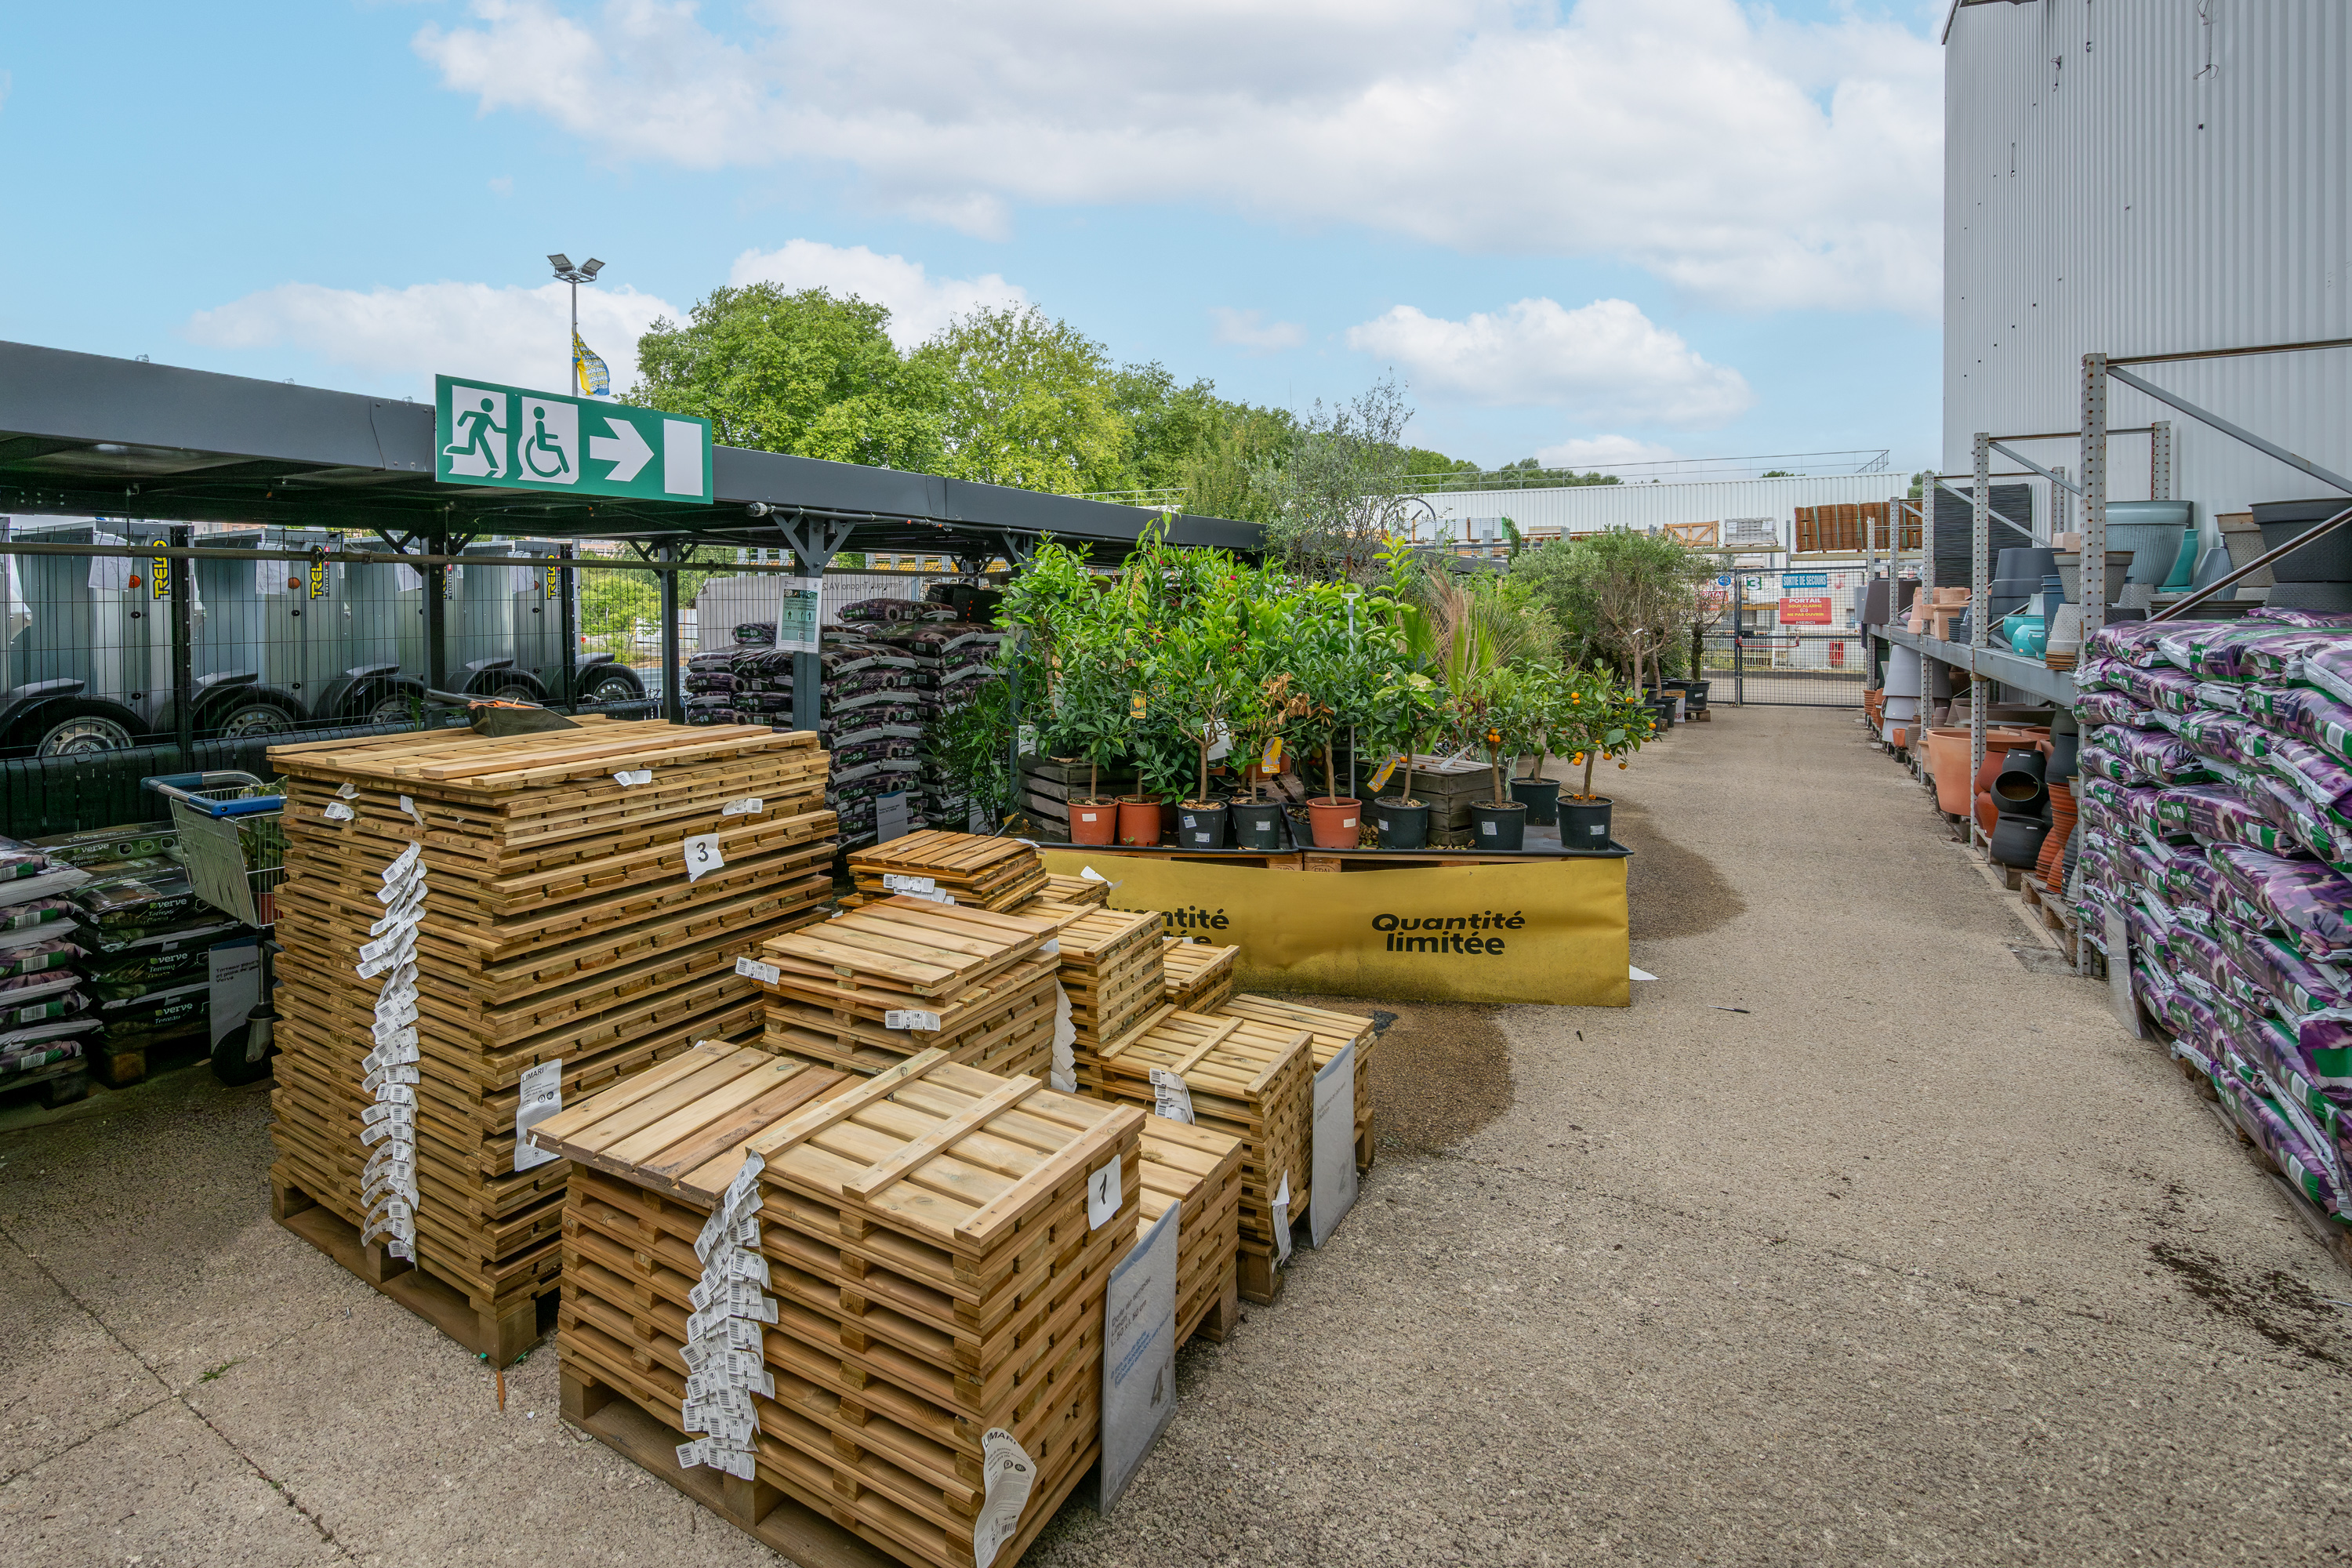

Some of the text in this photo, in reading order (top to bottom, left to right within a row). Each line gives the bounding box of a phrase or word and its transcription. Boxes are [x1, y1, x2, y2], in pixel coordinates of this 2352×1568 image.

[1747, 576, 1761, 590] 3
[1784, 575, 1827, 586] SORTIE DE SECOURS
[81, 844, 109, 853] verve
[696, 841, 709, 862] 3
[158, 898, 187, 909] verve
[1372, 910, 1526, 931] Quantité
[1387, 931, 1505, 955] limitée
[158, 953, 188, 964] verve
[163, 1003, 193, 1014] verve
[521, 1067, 544, 1083] LIMARI
[1099, 1173, 1106, 1205] 1
[1116, 1329, 1124, 1341] 50
[1139, 1300, 1147, 1312] cm
[1150, 1366, 1163, 1409] 4
[983, 1432, 1016, 1448] LIMARI
